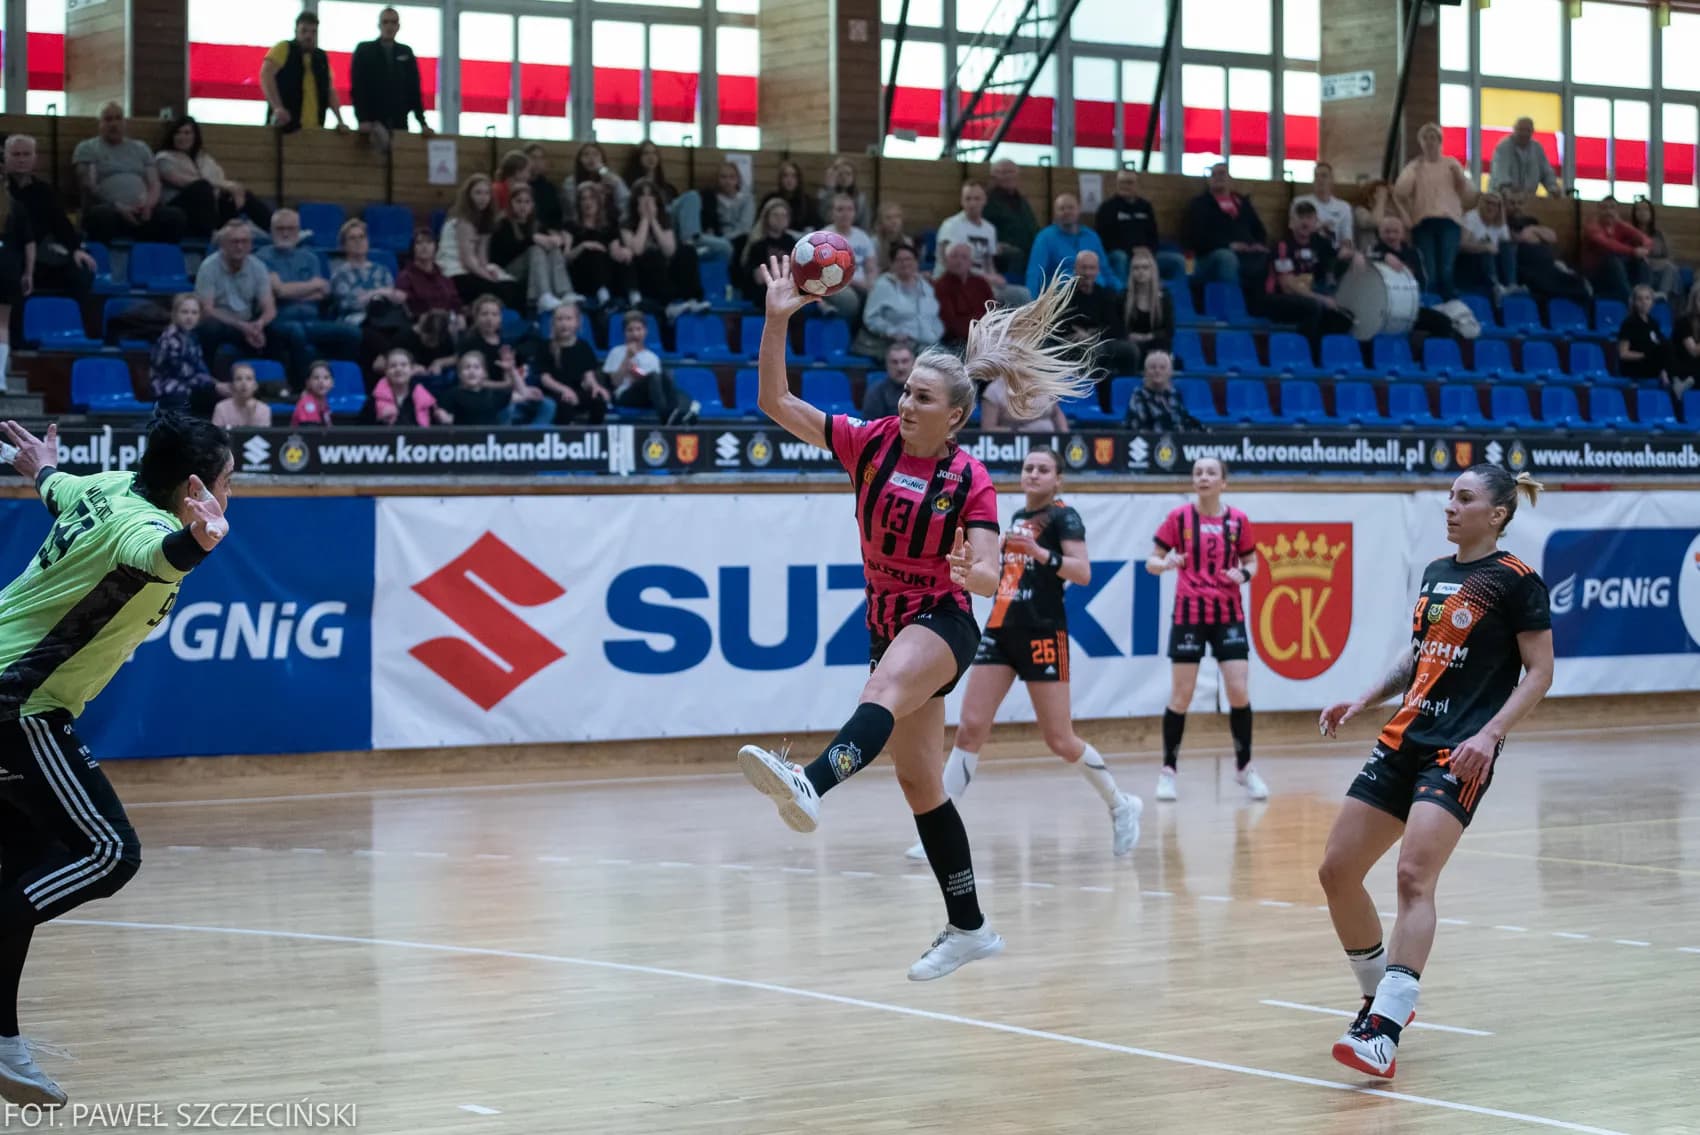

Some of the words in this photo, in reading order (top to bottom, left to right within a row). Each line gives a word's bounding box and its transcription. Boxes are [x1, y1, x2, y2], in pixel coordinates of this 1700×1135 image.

[1183, 437, 1425, 471] www.koronahandball.pl
[1532, 443, 1700, 468] www.koronahandb
[881, 493, 914, 535] 13
[1207, 537, 1218, 559] 2
[868, 559, 937, 587] SUZUKI
[1581, 577, 1672, 609] PGNiG
[1258, 585, 1332, 662] CK
[1030, 639, 1057, 664] 26
